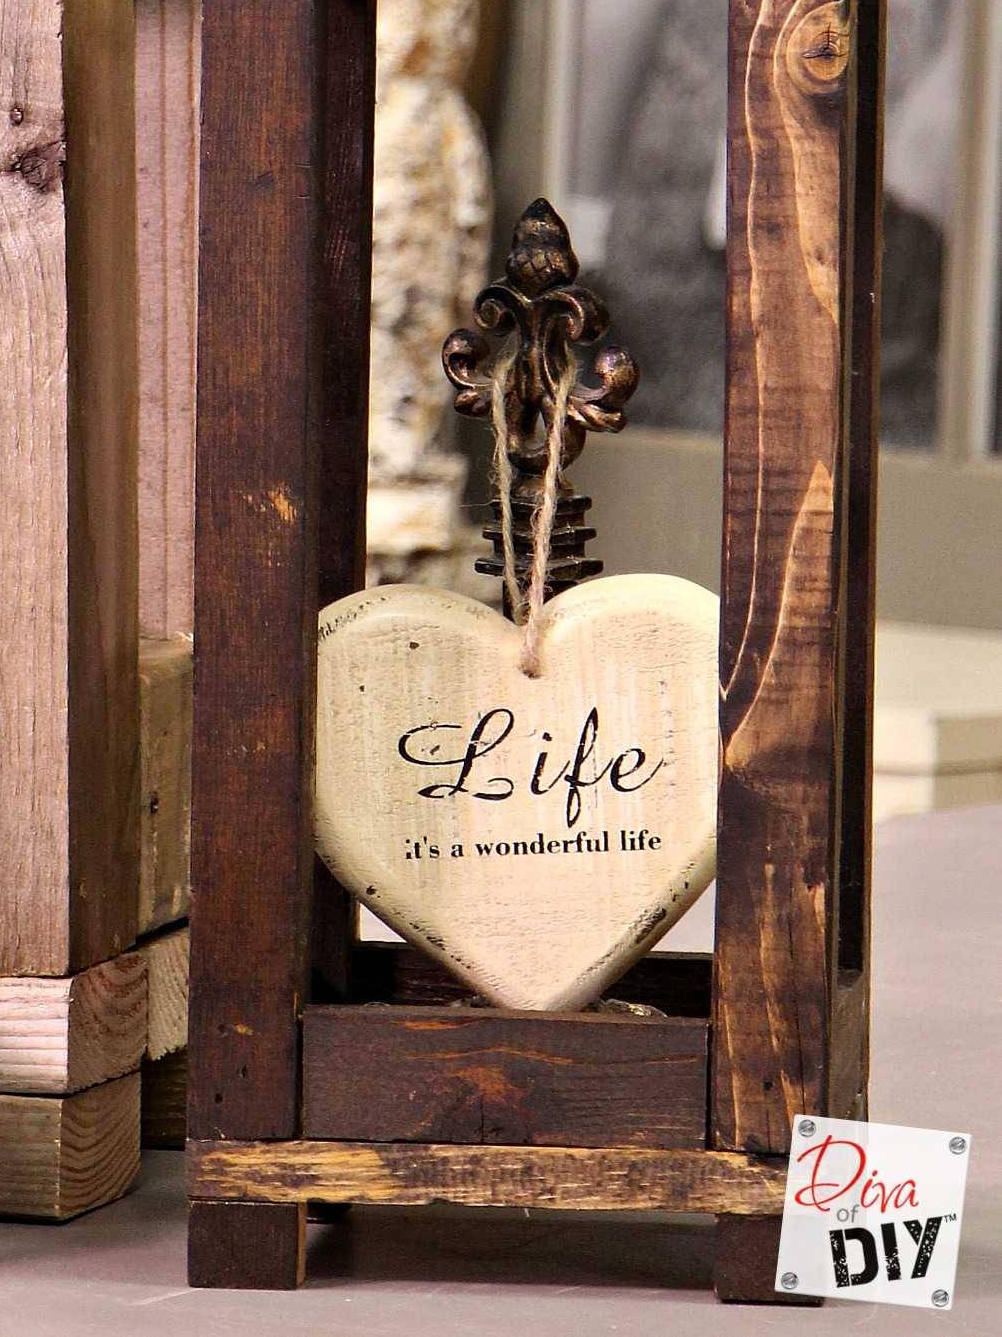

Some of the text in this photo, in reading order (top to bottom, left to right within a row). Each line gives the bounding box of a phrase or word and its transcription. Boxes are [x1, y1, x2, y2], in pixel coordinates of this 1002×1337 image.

[398, 707, 665, 828] Life
[405, 828, 663, 860] it's a wonderful life
